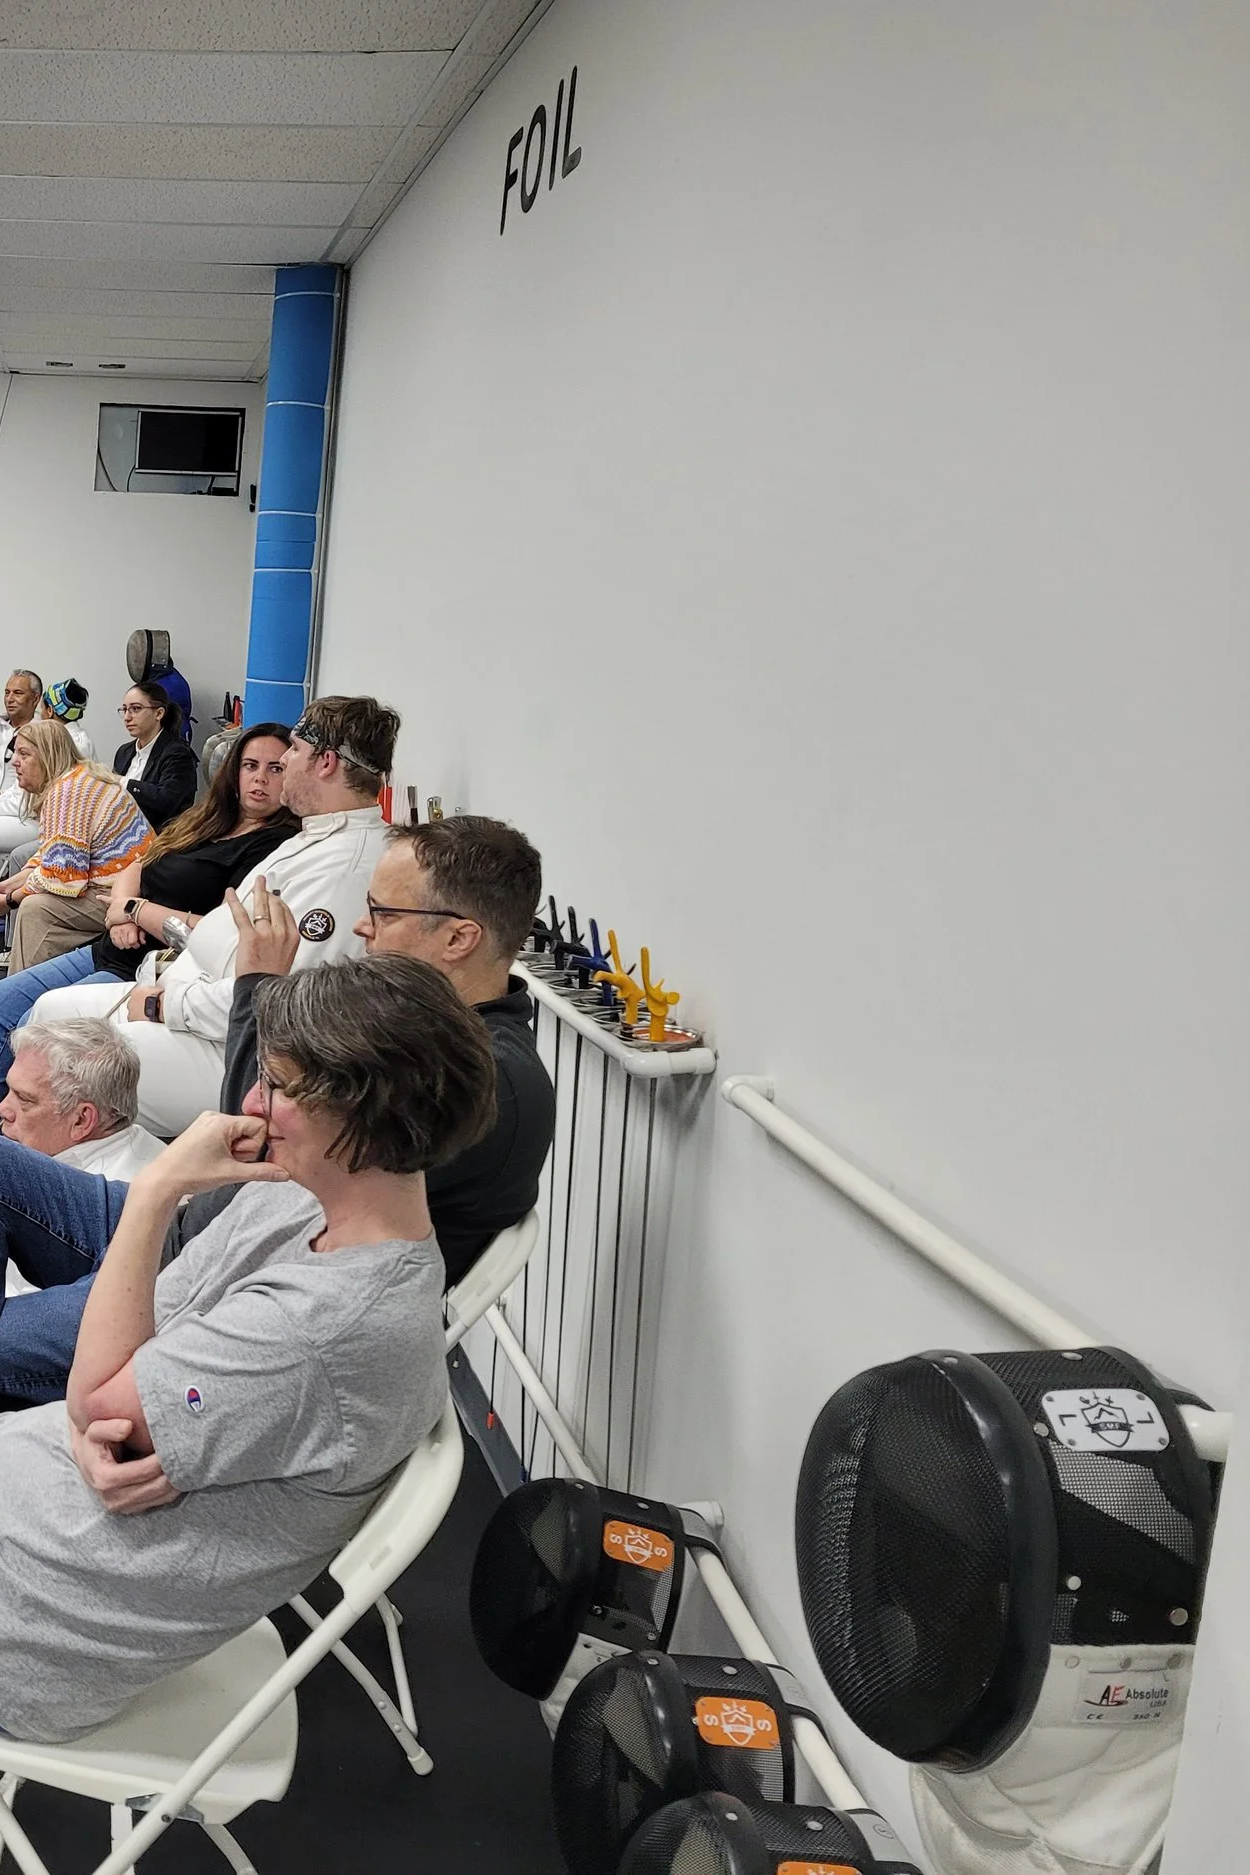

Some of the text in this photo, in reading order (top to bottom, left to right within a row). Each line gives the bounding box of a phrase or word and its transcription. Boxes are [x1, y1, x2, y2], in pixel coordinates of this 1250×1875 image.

[500, 65, 582, 236] FOIL
[609, 1533, 623, 1545] S
[654, 1546, 668, 1558] S
[1125, 1687, 1169, 1700] Absolute
[703, 1713, 719, 1726] S
[756, 1718, 772, 1732] S
